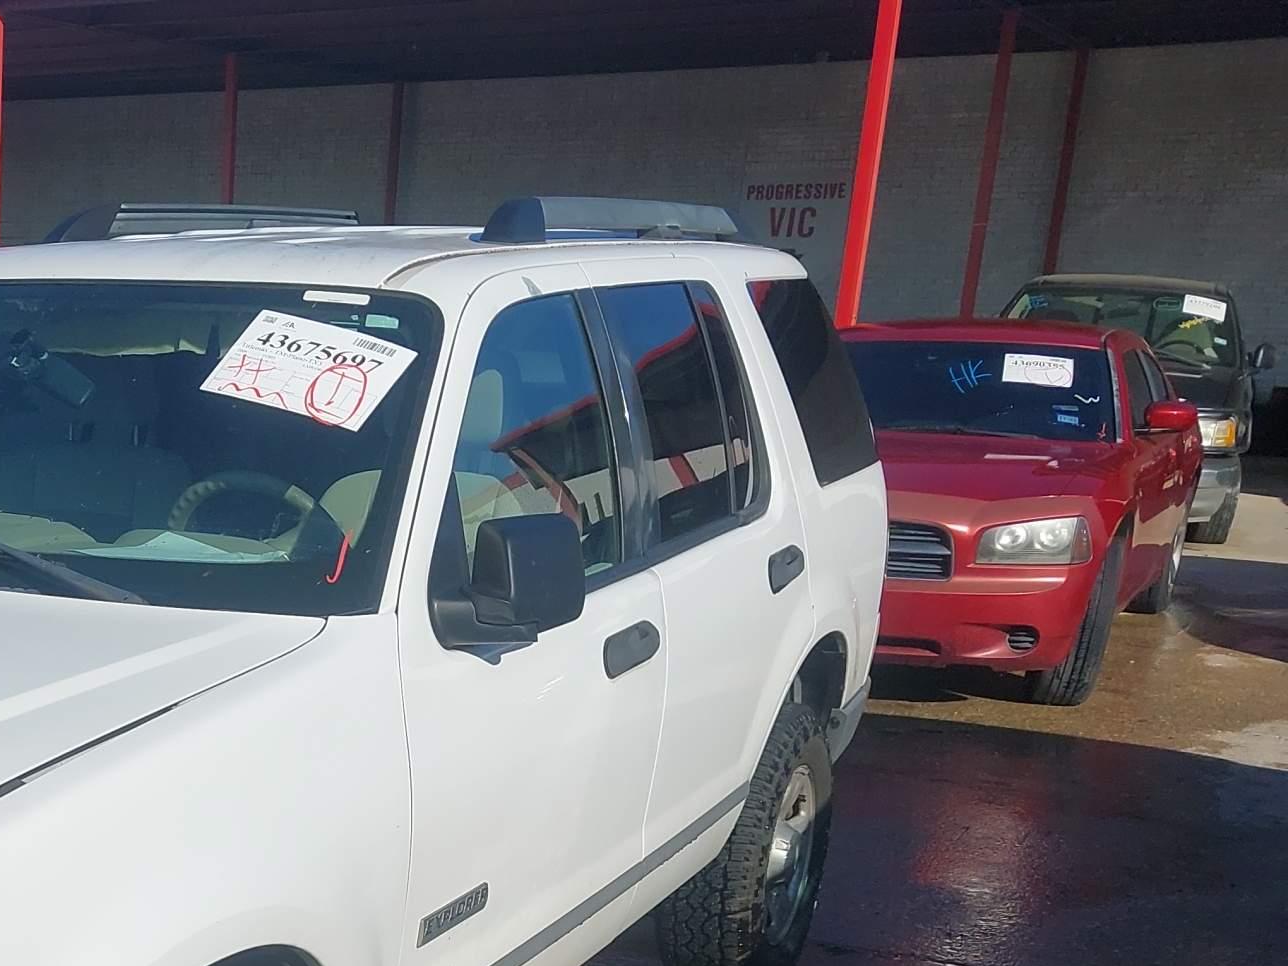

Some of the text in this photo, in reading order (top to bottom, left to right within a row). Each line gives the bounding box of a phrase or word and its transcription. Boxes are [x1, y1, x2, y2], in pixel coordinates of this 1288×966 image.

[746, 182, 847, 201] PROGRESSIVE
[769, 207, 817, 238] VIC
[256, 331, 384, 374] 43675697
[948, 359, 993, 394] HK
